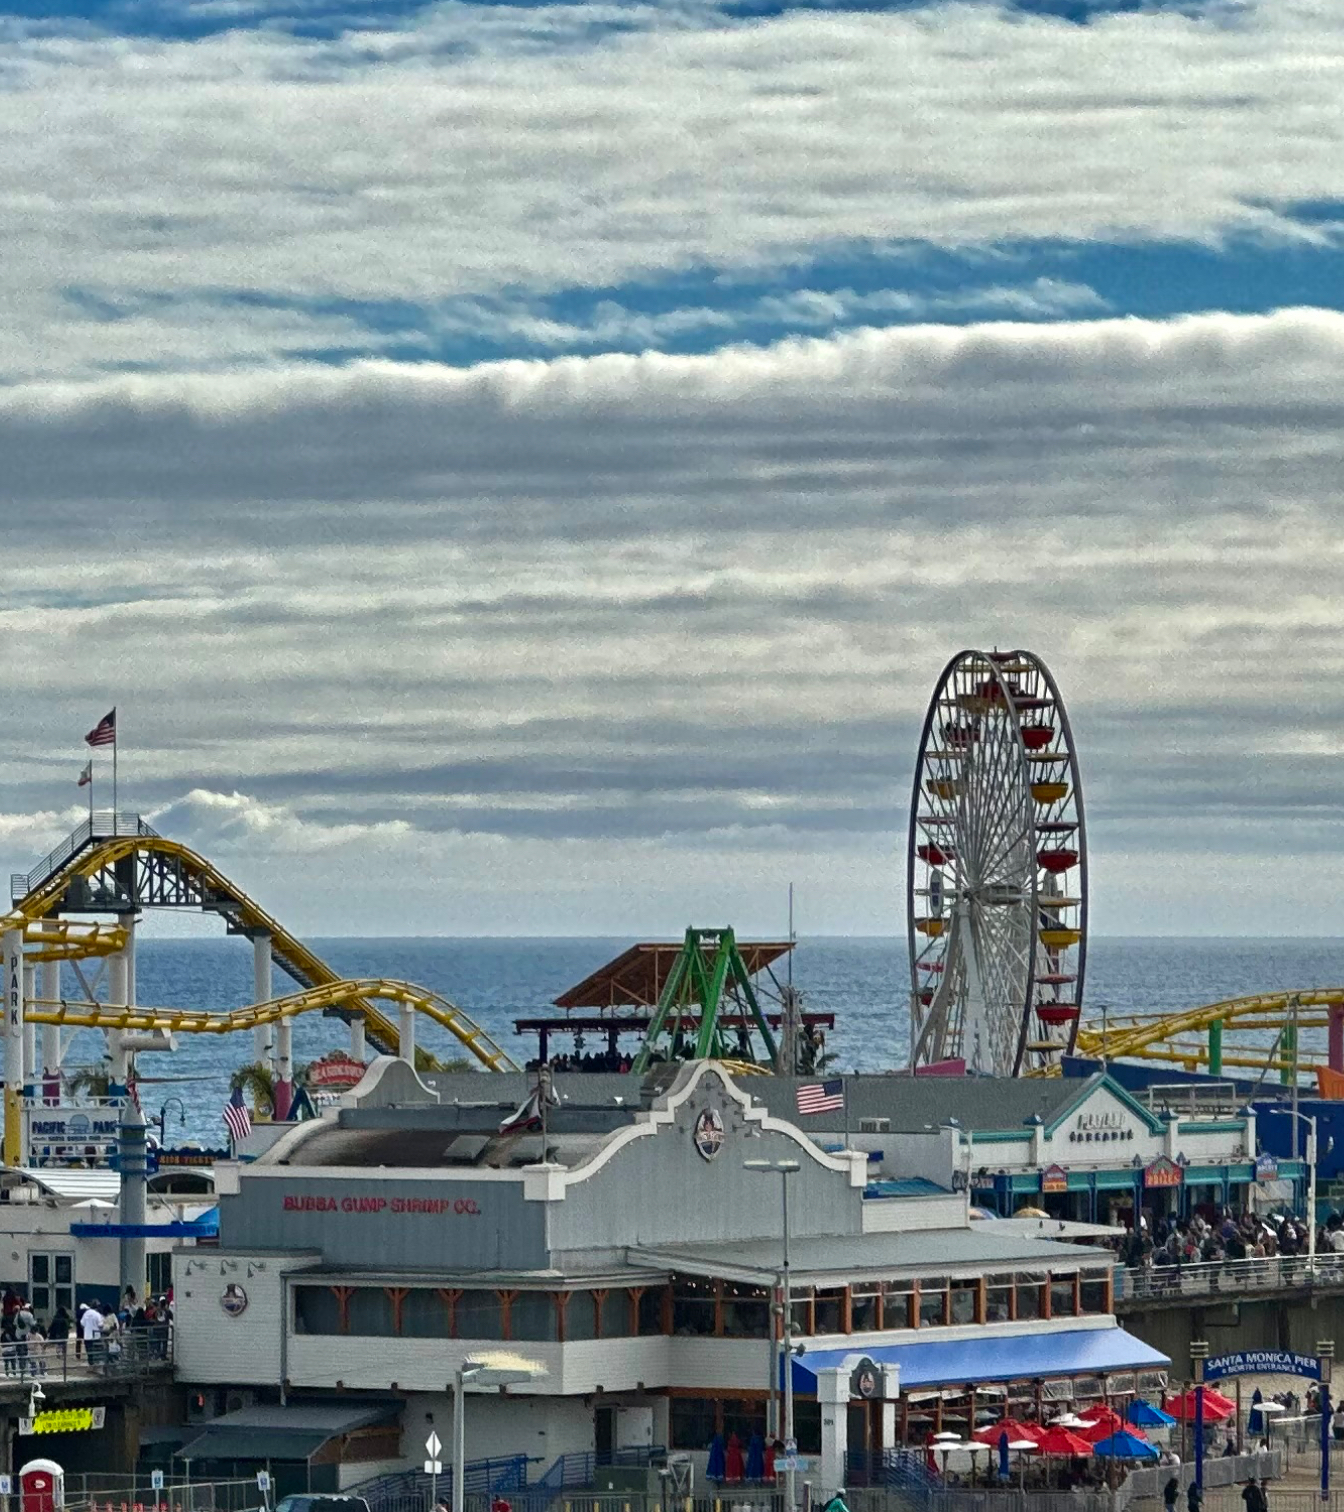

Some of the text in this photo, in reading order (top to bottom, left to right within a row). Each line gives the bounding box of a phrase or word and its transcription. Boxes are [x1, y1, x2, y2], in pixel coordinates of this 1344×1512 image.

[10, 956, 19, 1026] PARK
[32, 1121, 66, 1133] PACIFIC
[283, 1195, 338, 1212] BUBBA
[341, 1196, 387, 1213] GUMP
[390, 1197, 449, 1214] SHRIMP
[1207, 1352, 1317, 1371] SANTA MONICA PIER
[1228, 1363, 1296, 1373] NORTH ENTRANCE
